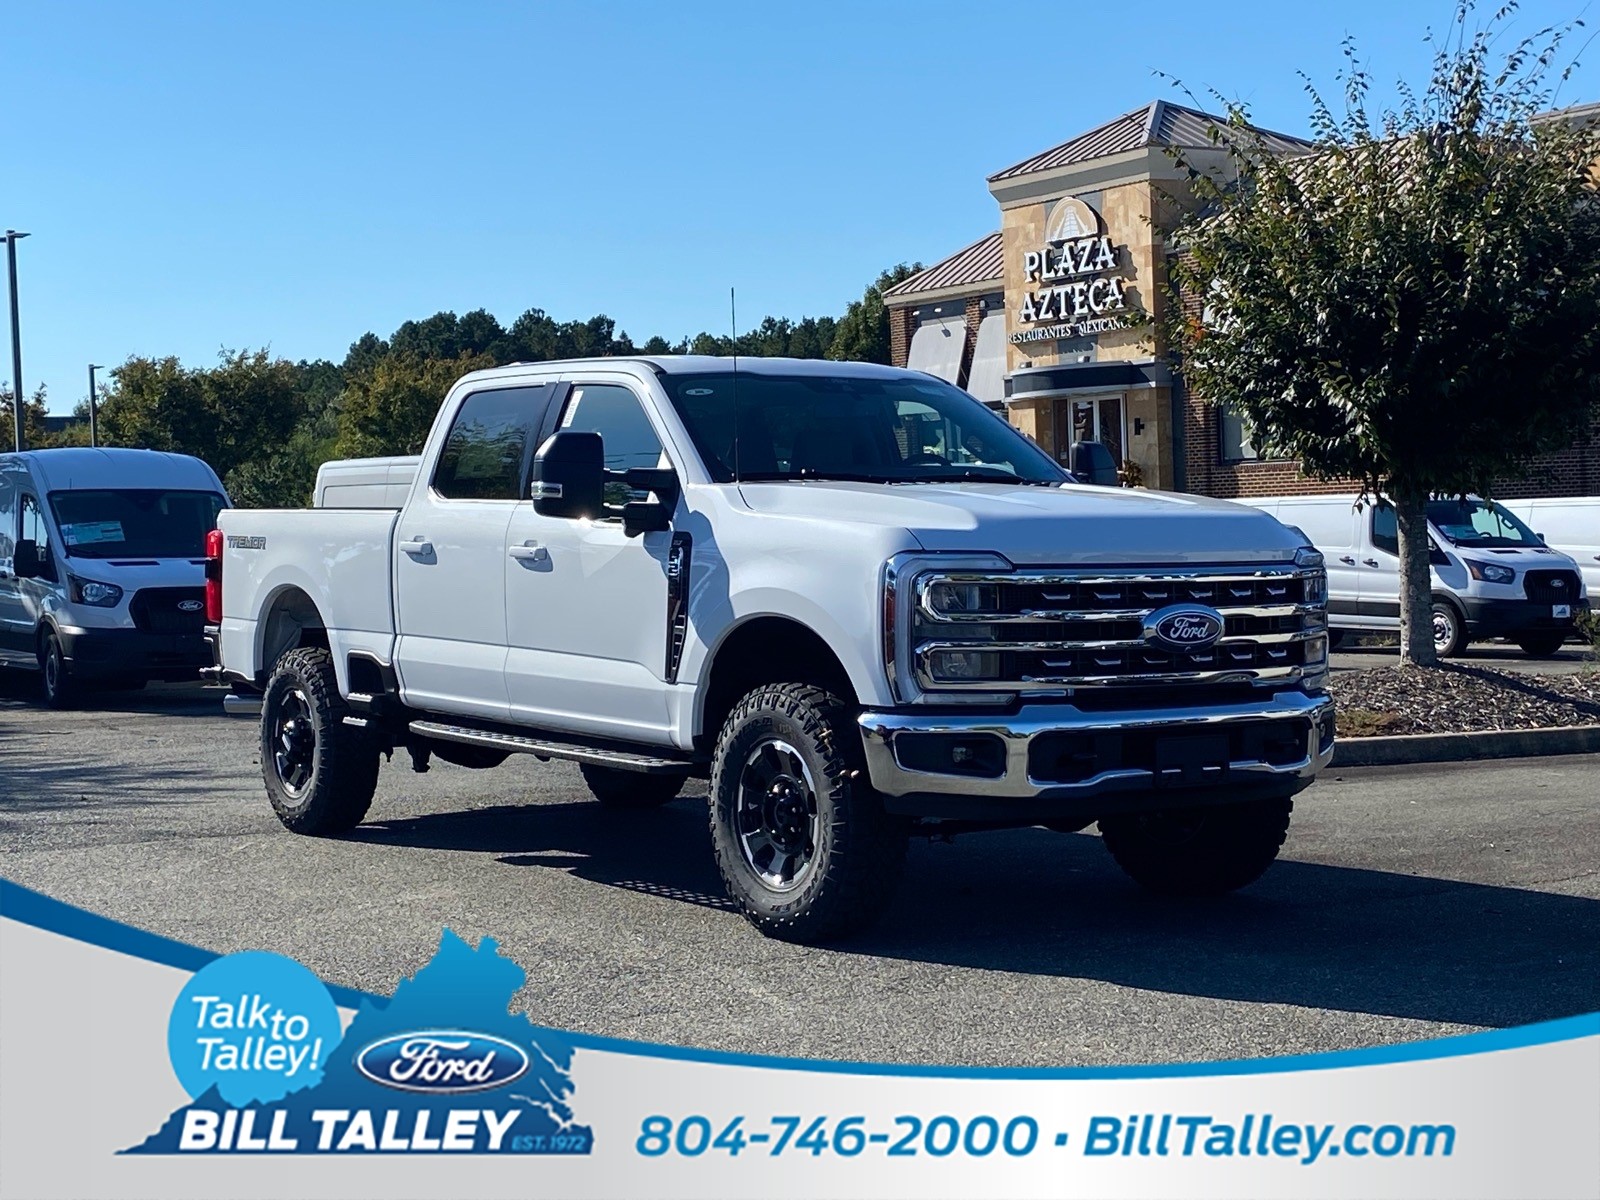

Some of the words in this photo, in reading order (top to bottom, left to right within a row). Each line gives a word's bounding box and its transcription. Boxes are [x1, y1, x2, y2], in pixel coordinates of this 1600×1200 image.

[1023, 237, 1116, 283] PLAZA
[1019, 276, 1125, 323] AZTECA
[1008, 323, 1072, 343] RESTAURANTES
[227, 535, 267, 550] TREMOR
[1169, 616, 1210, 638] Ford
